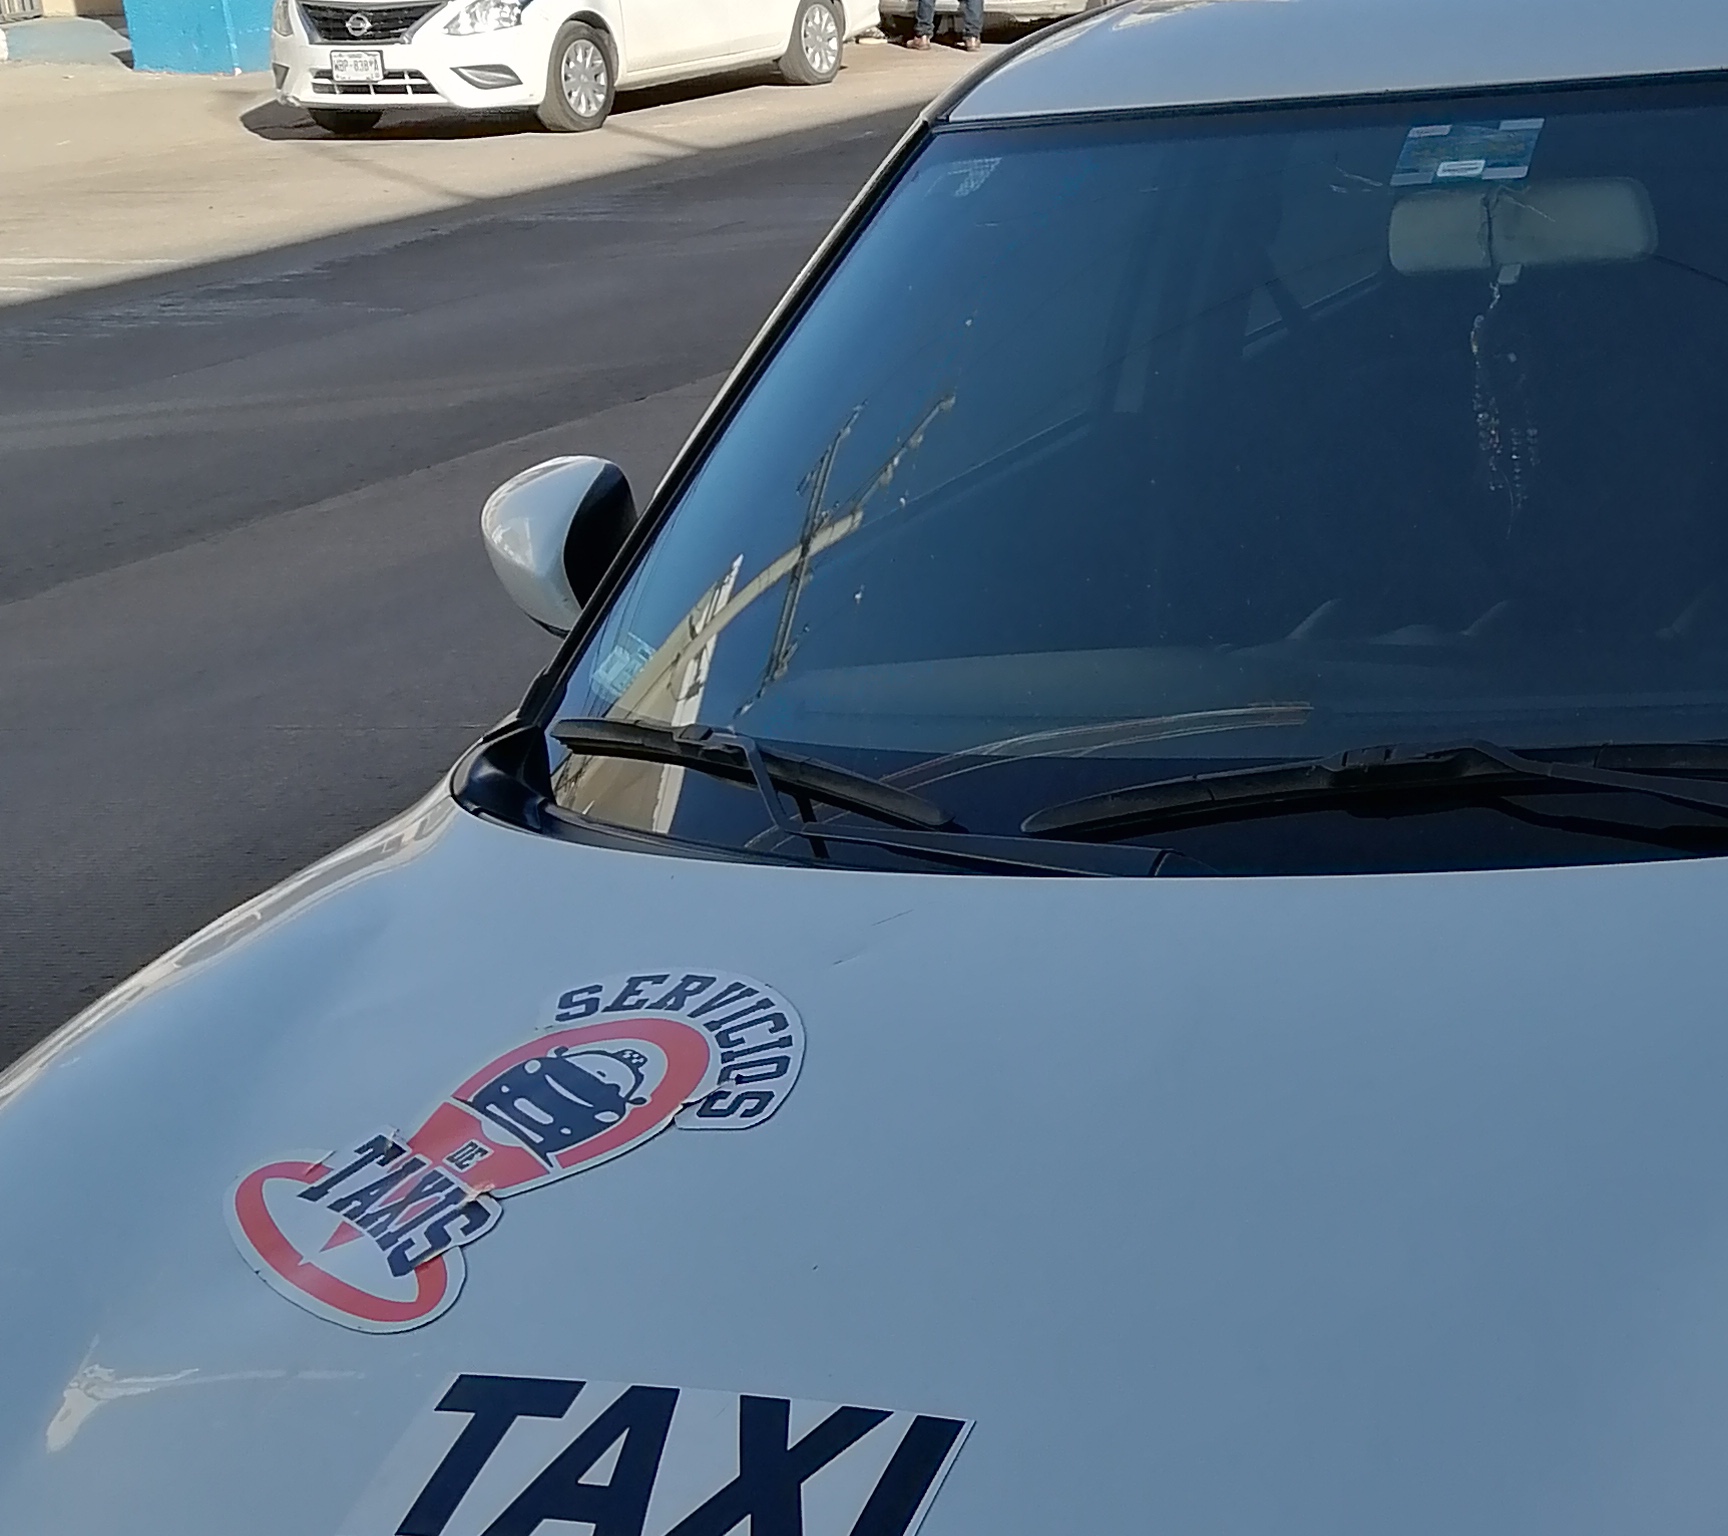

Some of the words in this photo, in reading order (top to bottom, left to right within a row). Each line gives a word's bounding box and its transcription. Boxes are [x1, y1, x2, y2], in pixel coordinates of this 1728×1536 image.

[555, 972, 795, 1121] SERVICIOS
[297, 1132, 492, 1278] TAXIS
[446, 1140, 489, 1171] DE
